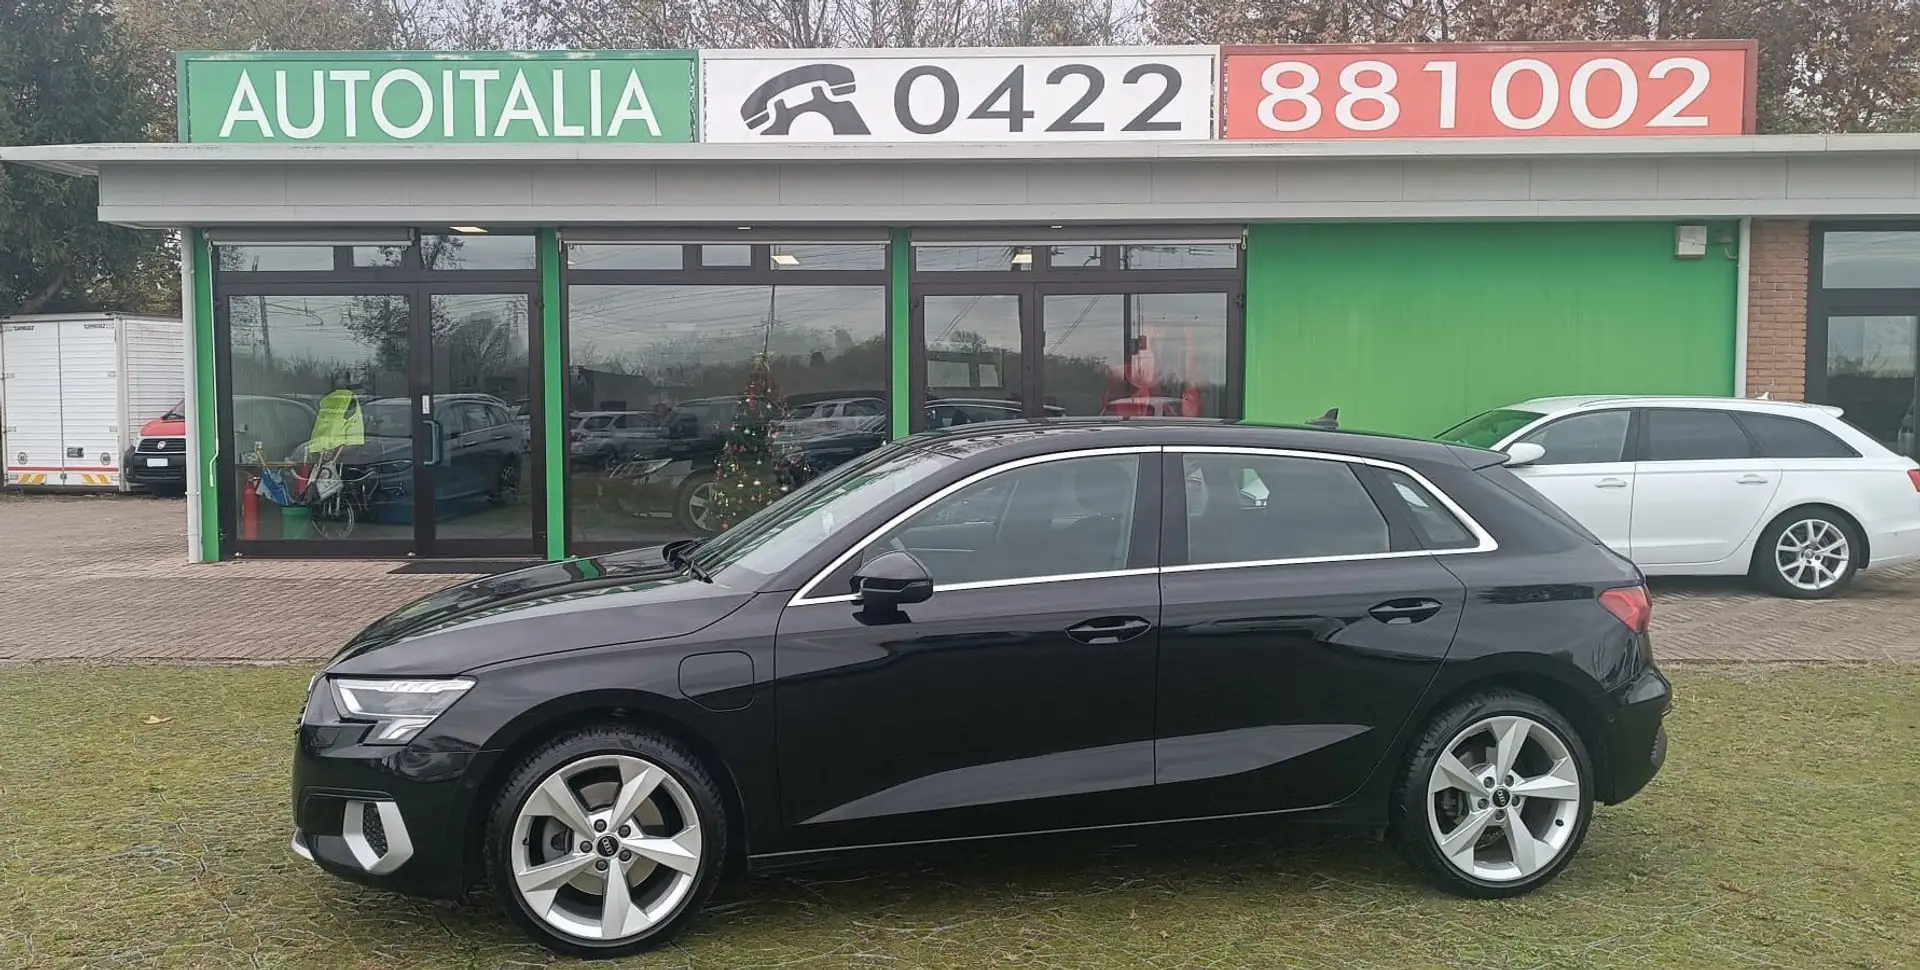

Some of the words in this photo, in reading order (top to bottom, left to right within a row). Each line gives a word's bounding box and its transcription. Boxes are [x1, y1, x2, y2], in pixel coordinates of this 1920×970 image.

[218, 67, 662, 139] AUTOITALIA
[893, 63, 1183, 135] 0422
[1257, 57, 1711, 132] 881002
